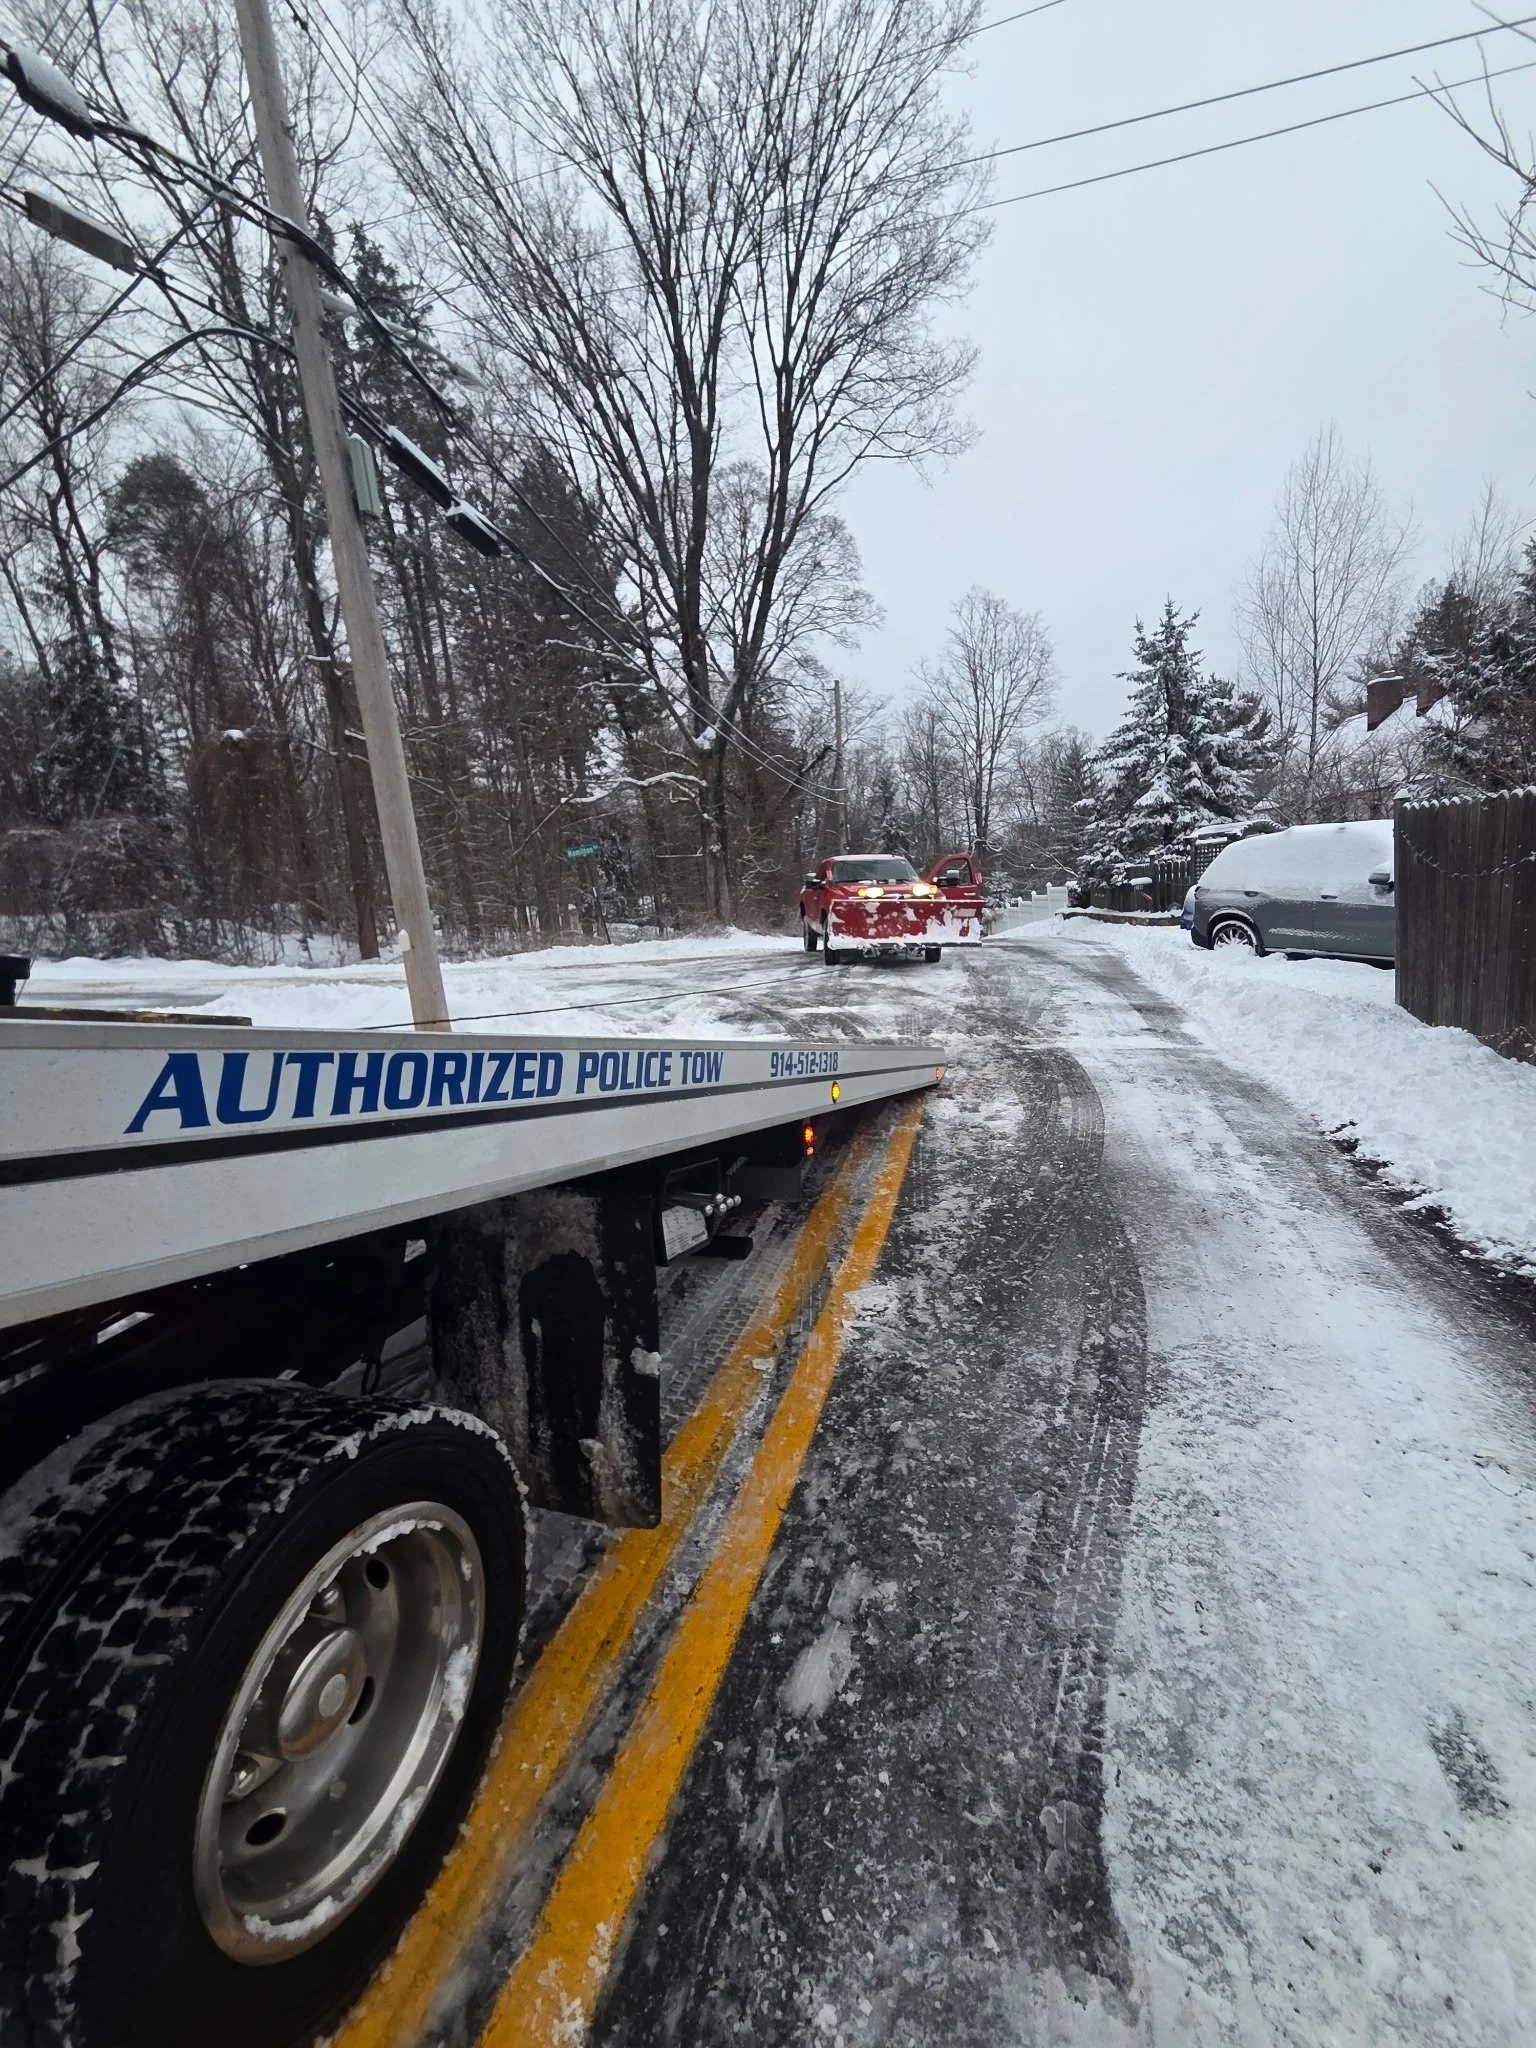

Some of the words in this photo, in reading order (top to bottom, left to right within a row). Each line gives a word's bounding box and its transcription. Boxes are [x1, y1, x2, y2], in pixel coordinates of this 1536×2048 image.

[771, 1052, 838, 1077] 914-512-1318
[123, 1052, 563, 1133] AUTHORIZED
[576, 1052, 672, 1094] POLICE
[680, 1052, 723, 1085] TOW
